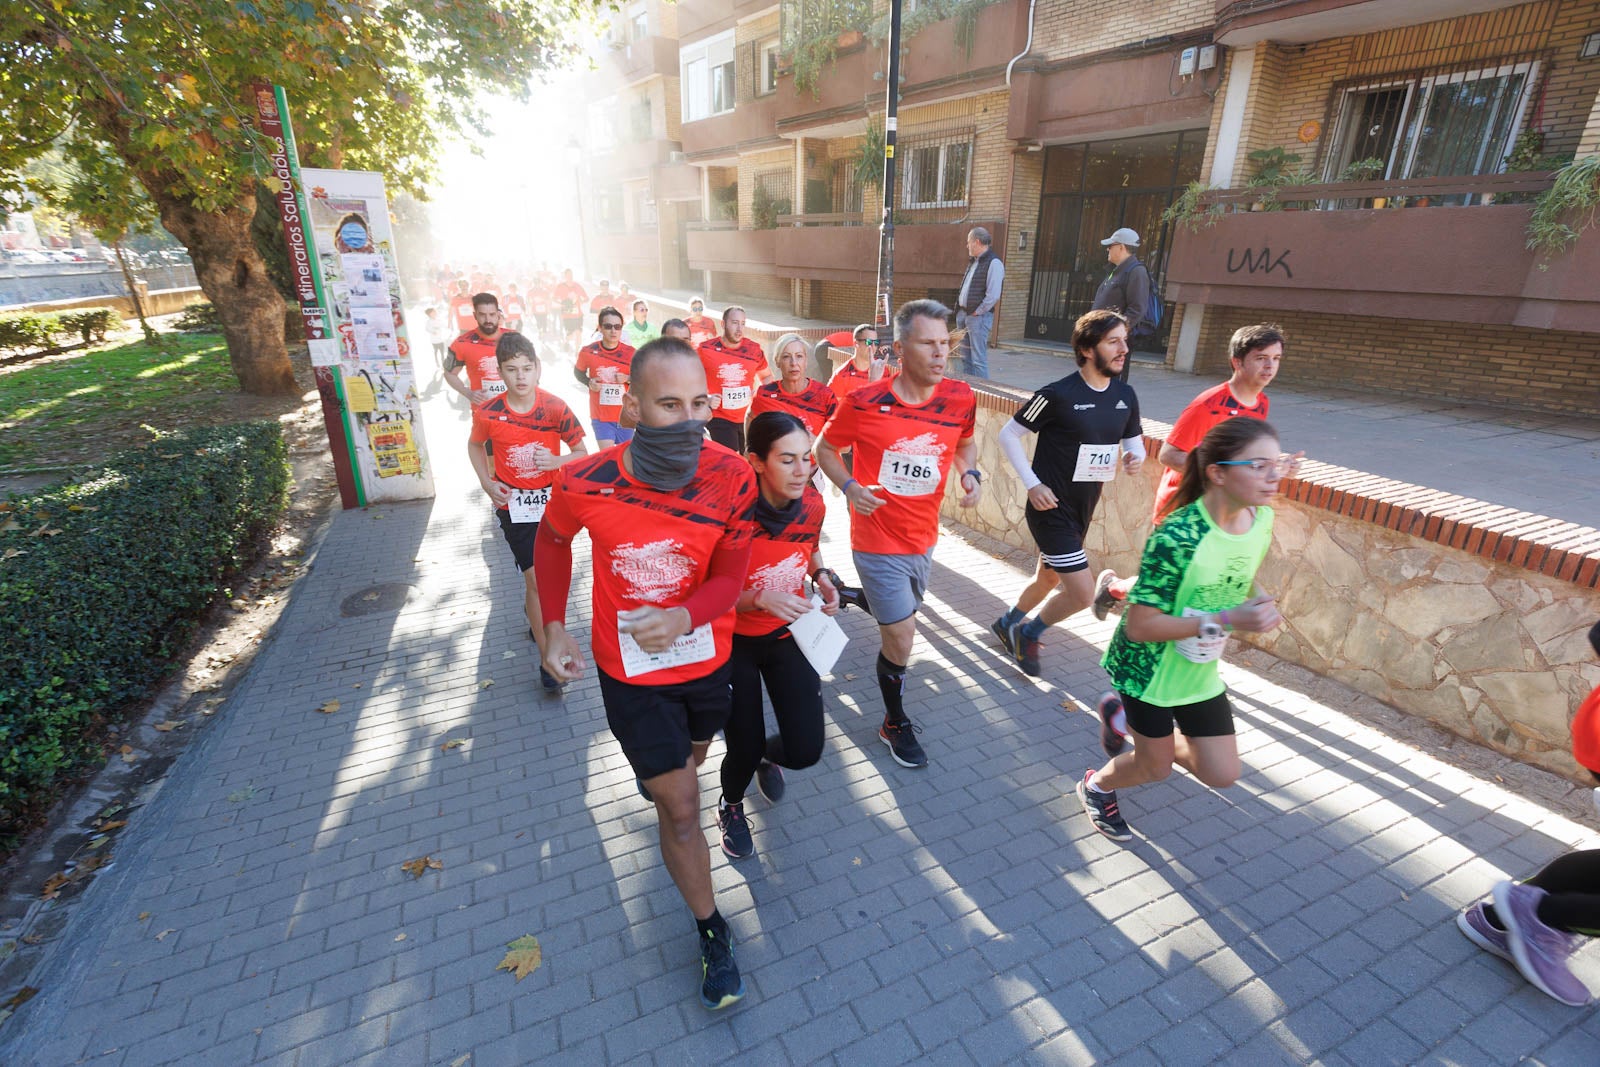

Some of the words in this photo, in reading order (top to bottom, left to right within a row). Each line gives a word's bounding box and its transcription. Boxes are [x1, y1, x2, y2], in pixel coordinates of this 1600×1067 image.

[1121, 174, 1129, 187] 2
[289, 226, 313, 295] tinerarios
[605, 388, 620, 396] 478
[727, 391, 746, 400] 1251
[1089, 453, 1111, 465] 710
[892, 461, 932, 479] 1186
[516, 494, 549, 507] 1448
